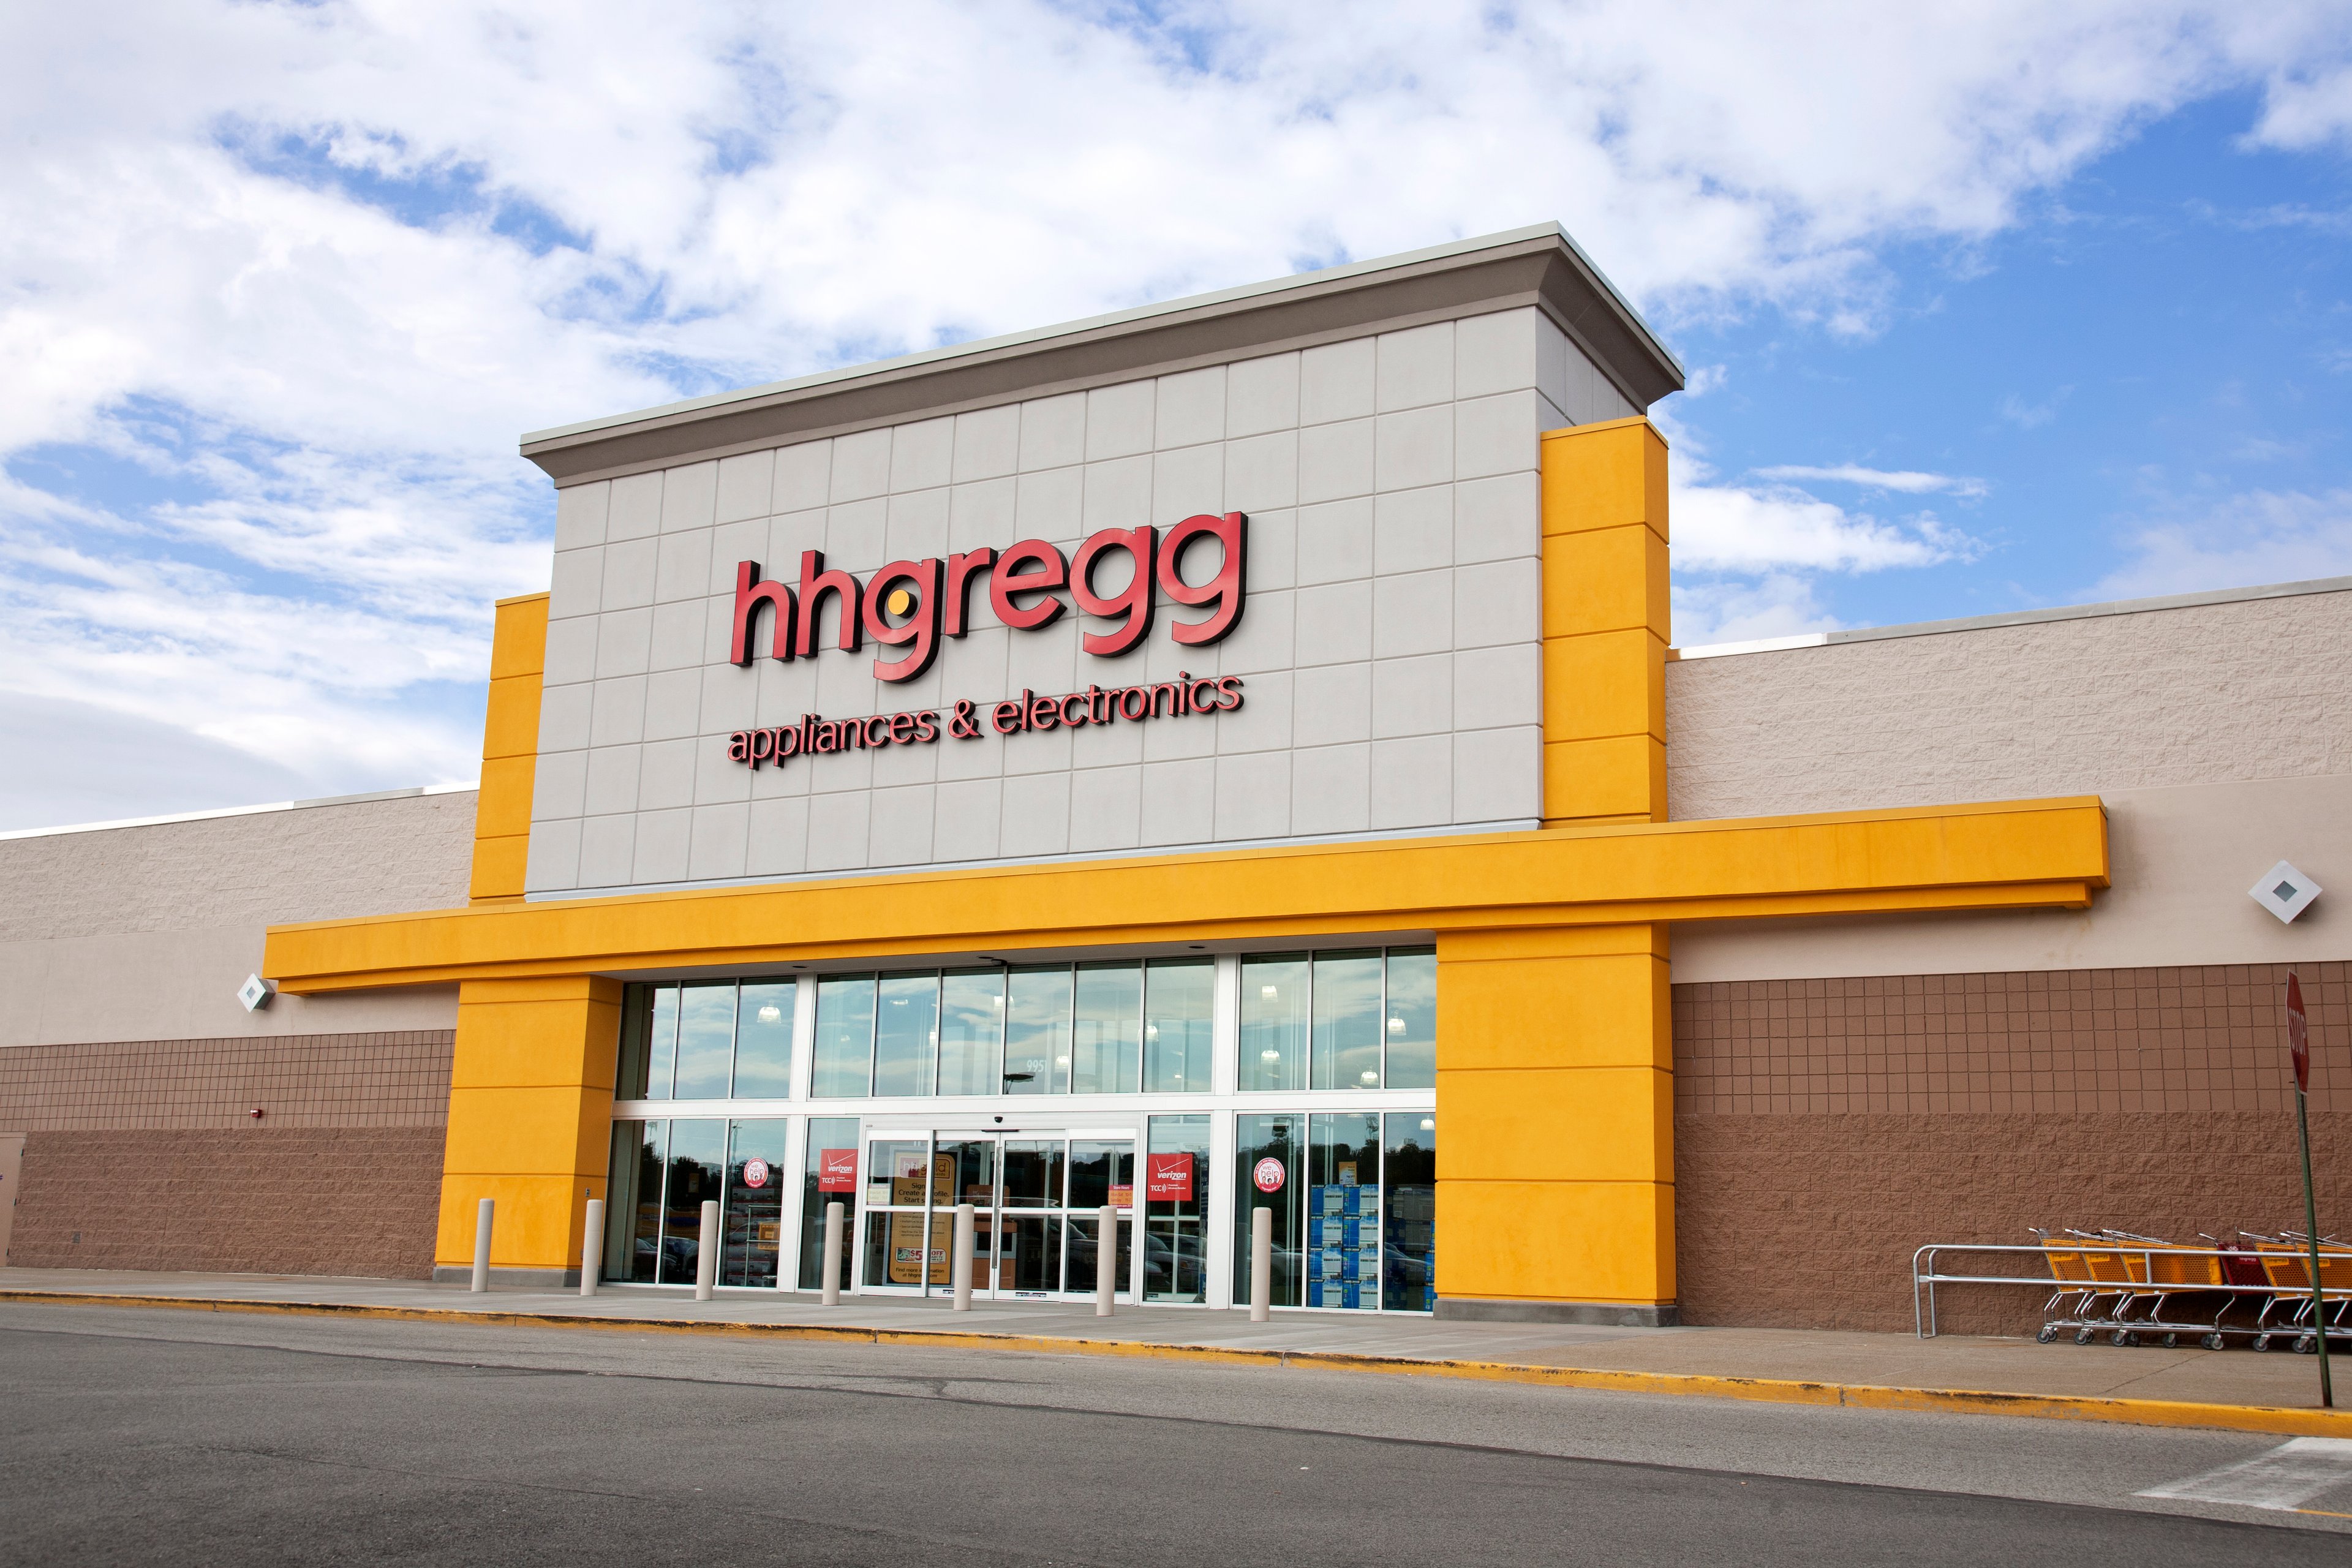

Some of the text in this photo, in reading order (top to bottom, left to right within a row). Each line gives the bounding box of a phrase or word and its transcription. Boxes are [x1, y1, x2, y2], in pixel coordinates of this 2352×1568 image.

[730, 511, 1248, 684] hhgregg
[727, 671, 1245, 770] appliances & electronics
[2289, 1007, 2306, 1056] STOP
[828, 1164, 853, 1174] verizon
[1157, 1170, 1187, 1180] verizon
[1261, 1169, 1280, 1178] help
